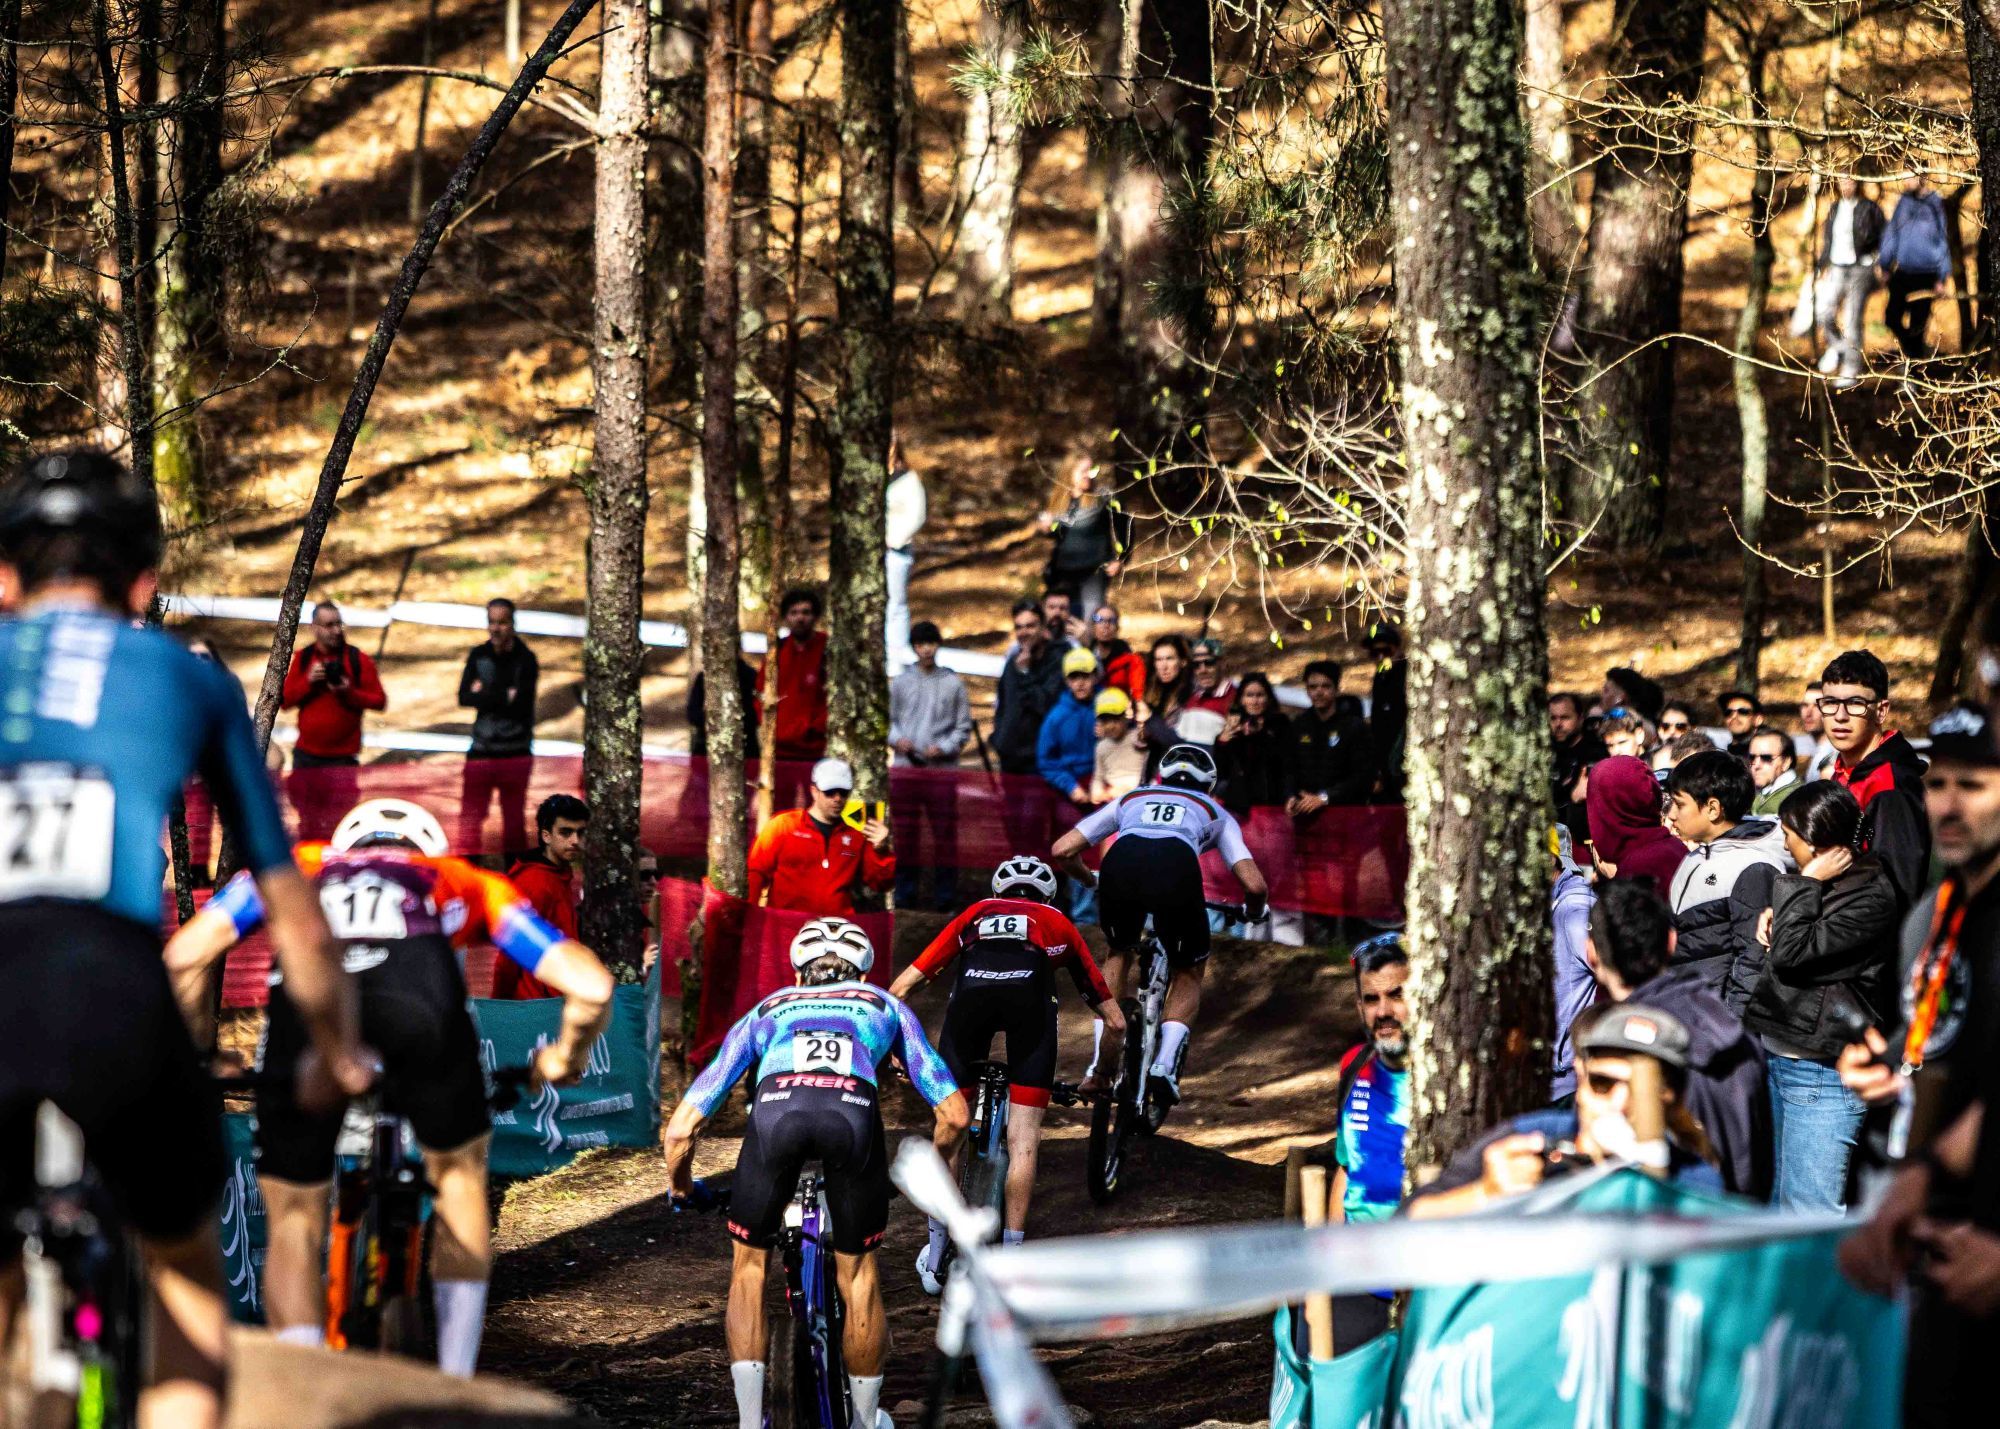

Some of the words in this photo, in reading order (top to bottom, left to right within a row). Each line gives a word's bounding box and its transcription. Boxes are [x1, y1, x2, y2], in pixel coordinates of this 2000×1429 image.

[1151, 805, 1176, 822] 18
[9, 800, 74, 869] 27
[343, 886, 382, 923] 17
[989, 917, 1017, 932] 16
[773, 1003, 853, 1019] unbroken
[806, 1039, 841, 1063] 29
[775, 1074, 858, 1092] TREK
